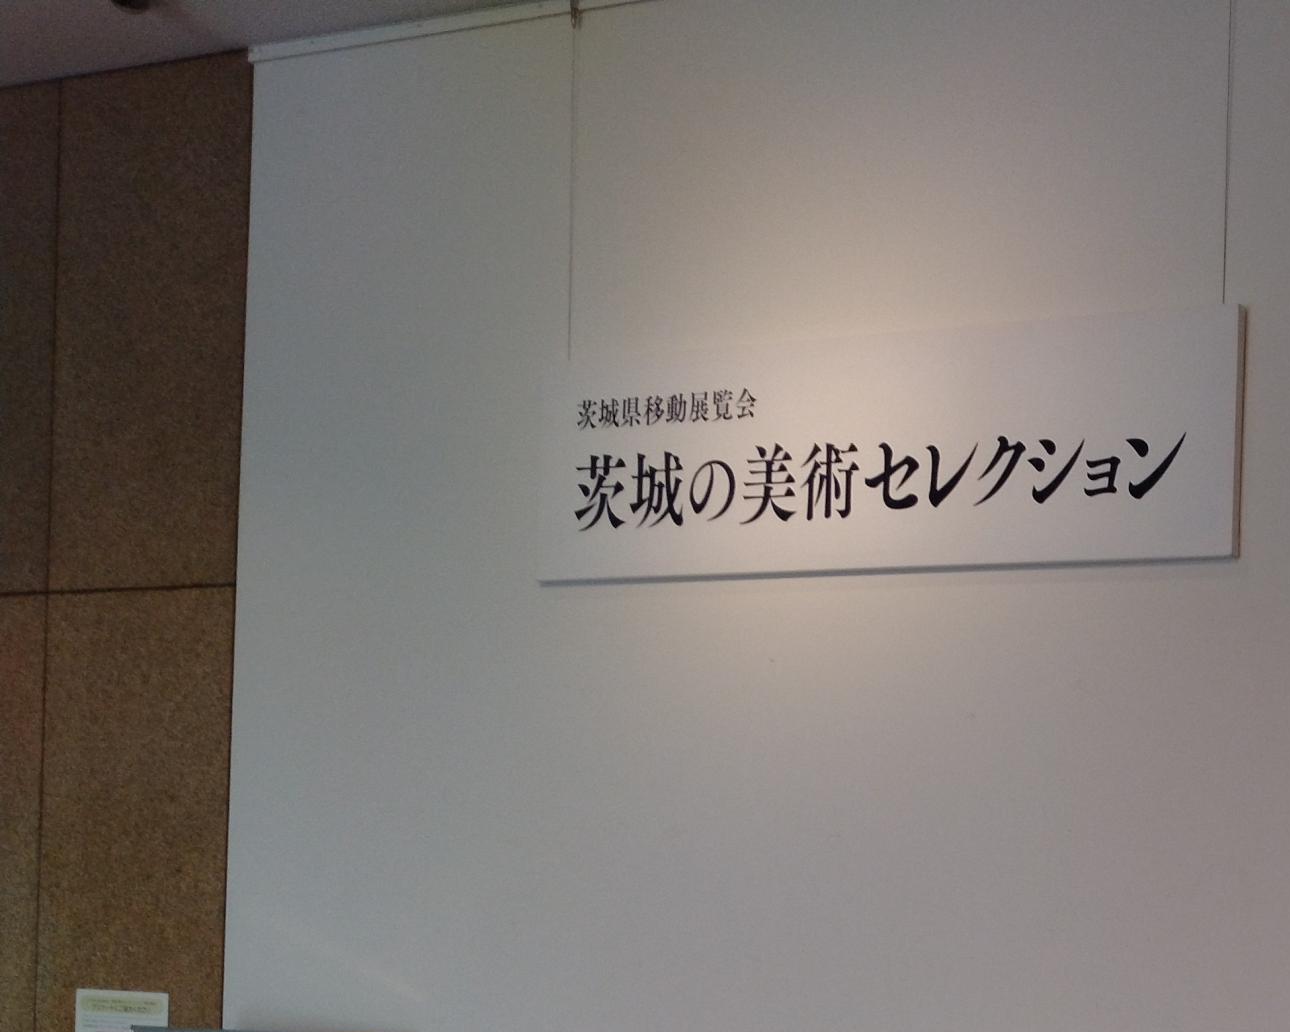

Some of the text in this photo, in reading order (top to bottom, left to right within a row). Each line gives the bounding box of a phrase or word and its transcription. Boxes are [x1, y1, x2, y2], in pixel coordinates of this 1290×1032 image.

[576, 388, 757, 430] 茨城県移動展覧会
[574, 431, 1187, 533] 茨城の美術セレクション
